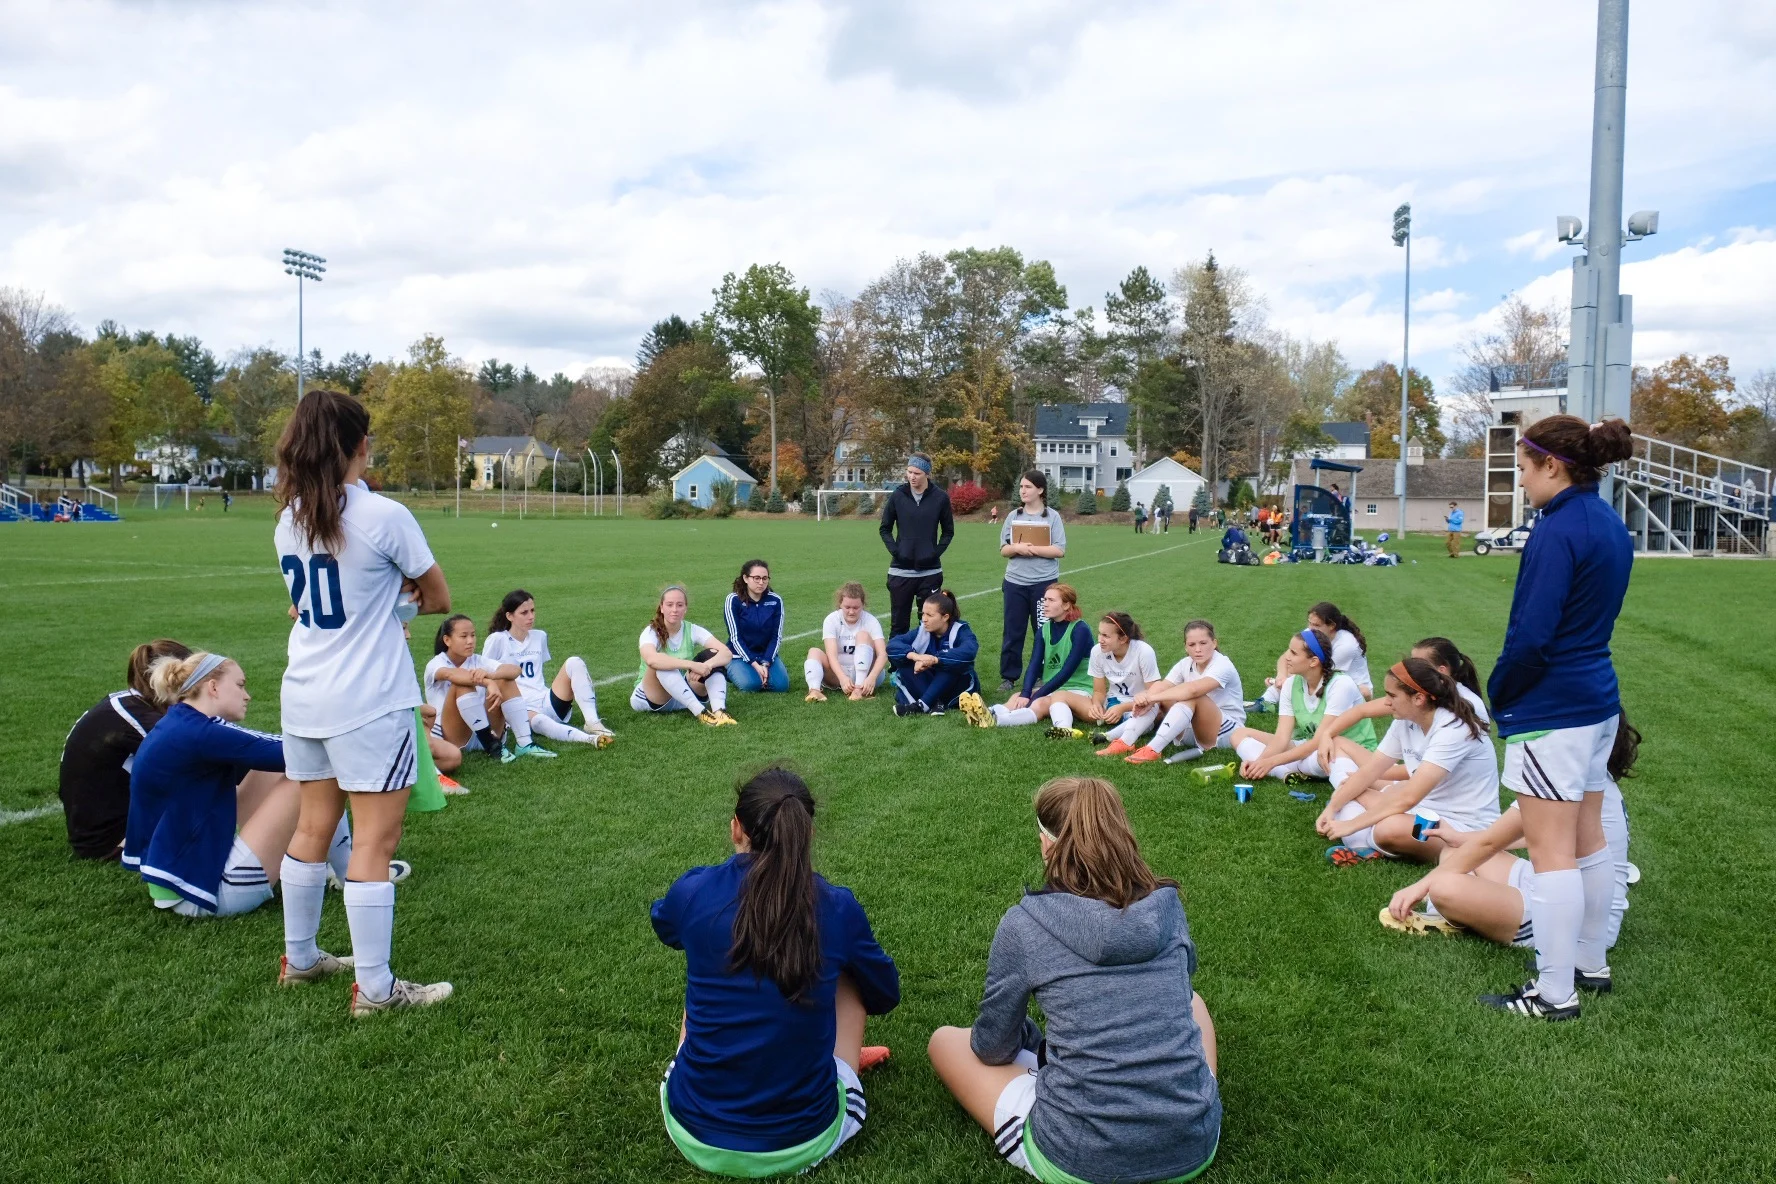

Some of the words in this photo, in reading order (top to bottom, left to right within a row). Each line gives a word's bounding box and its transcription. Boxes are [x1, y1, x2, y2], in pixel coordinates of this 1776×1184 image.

[281, 553, 347, 630] 20
[519, 661, 535, 678] 10
[1114, 682, 1130, 696] 11
